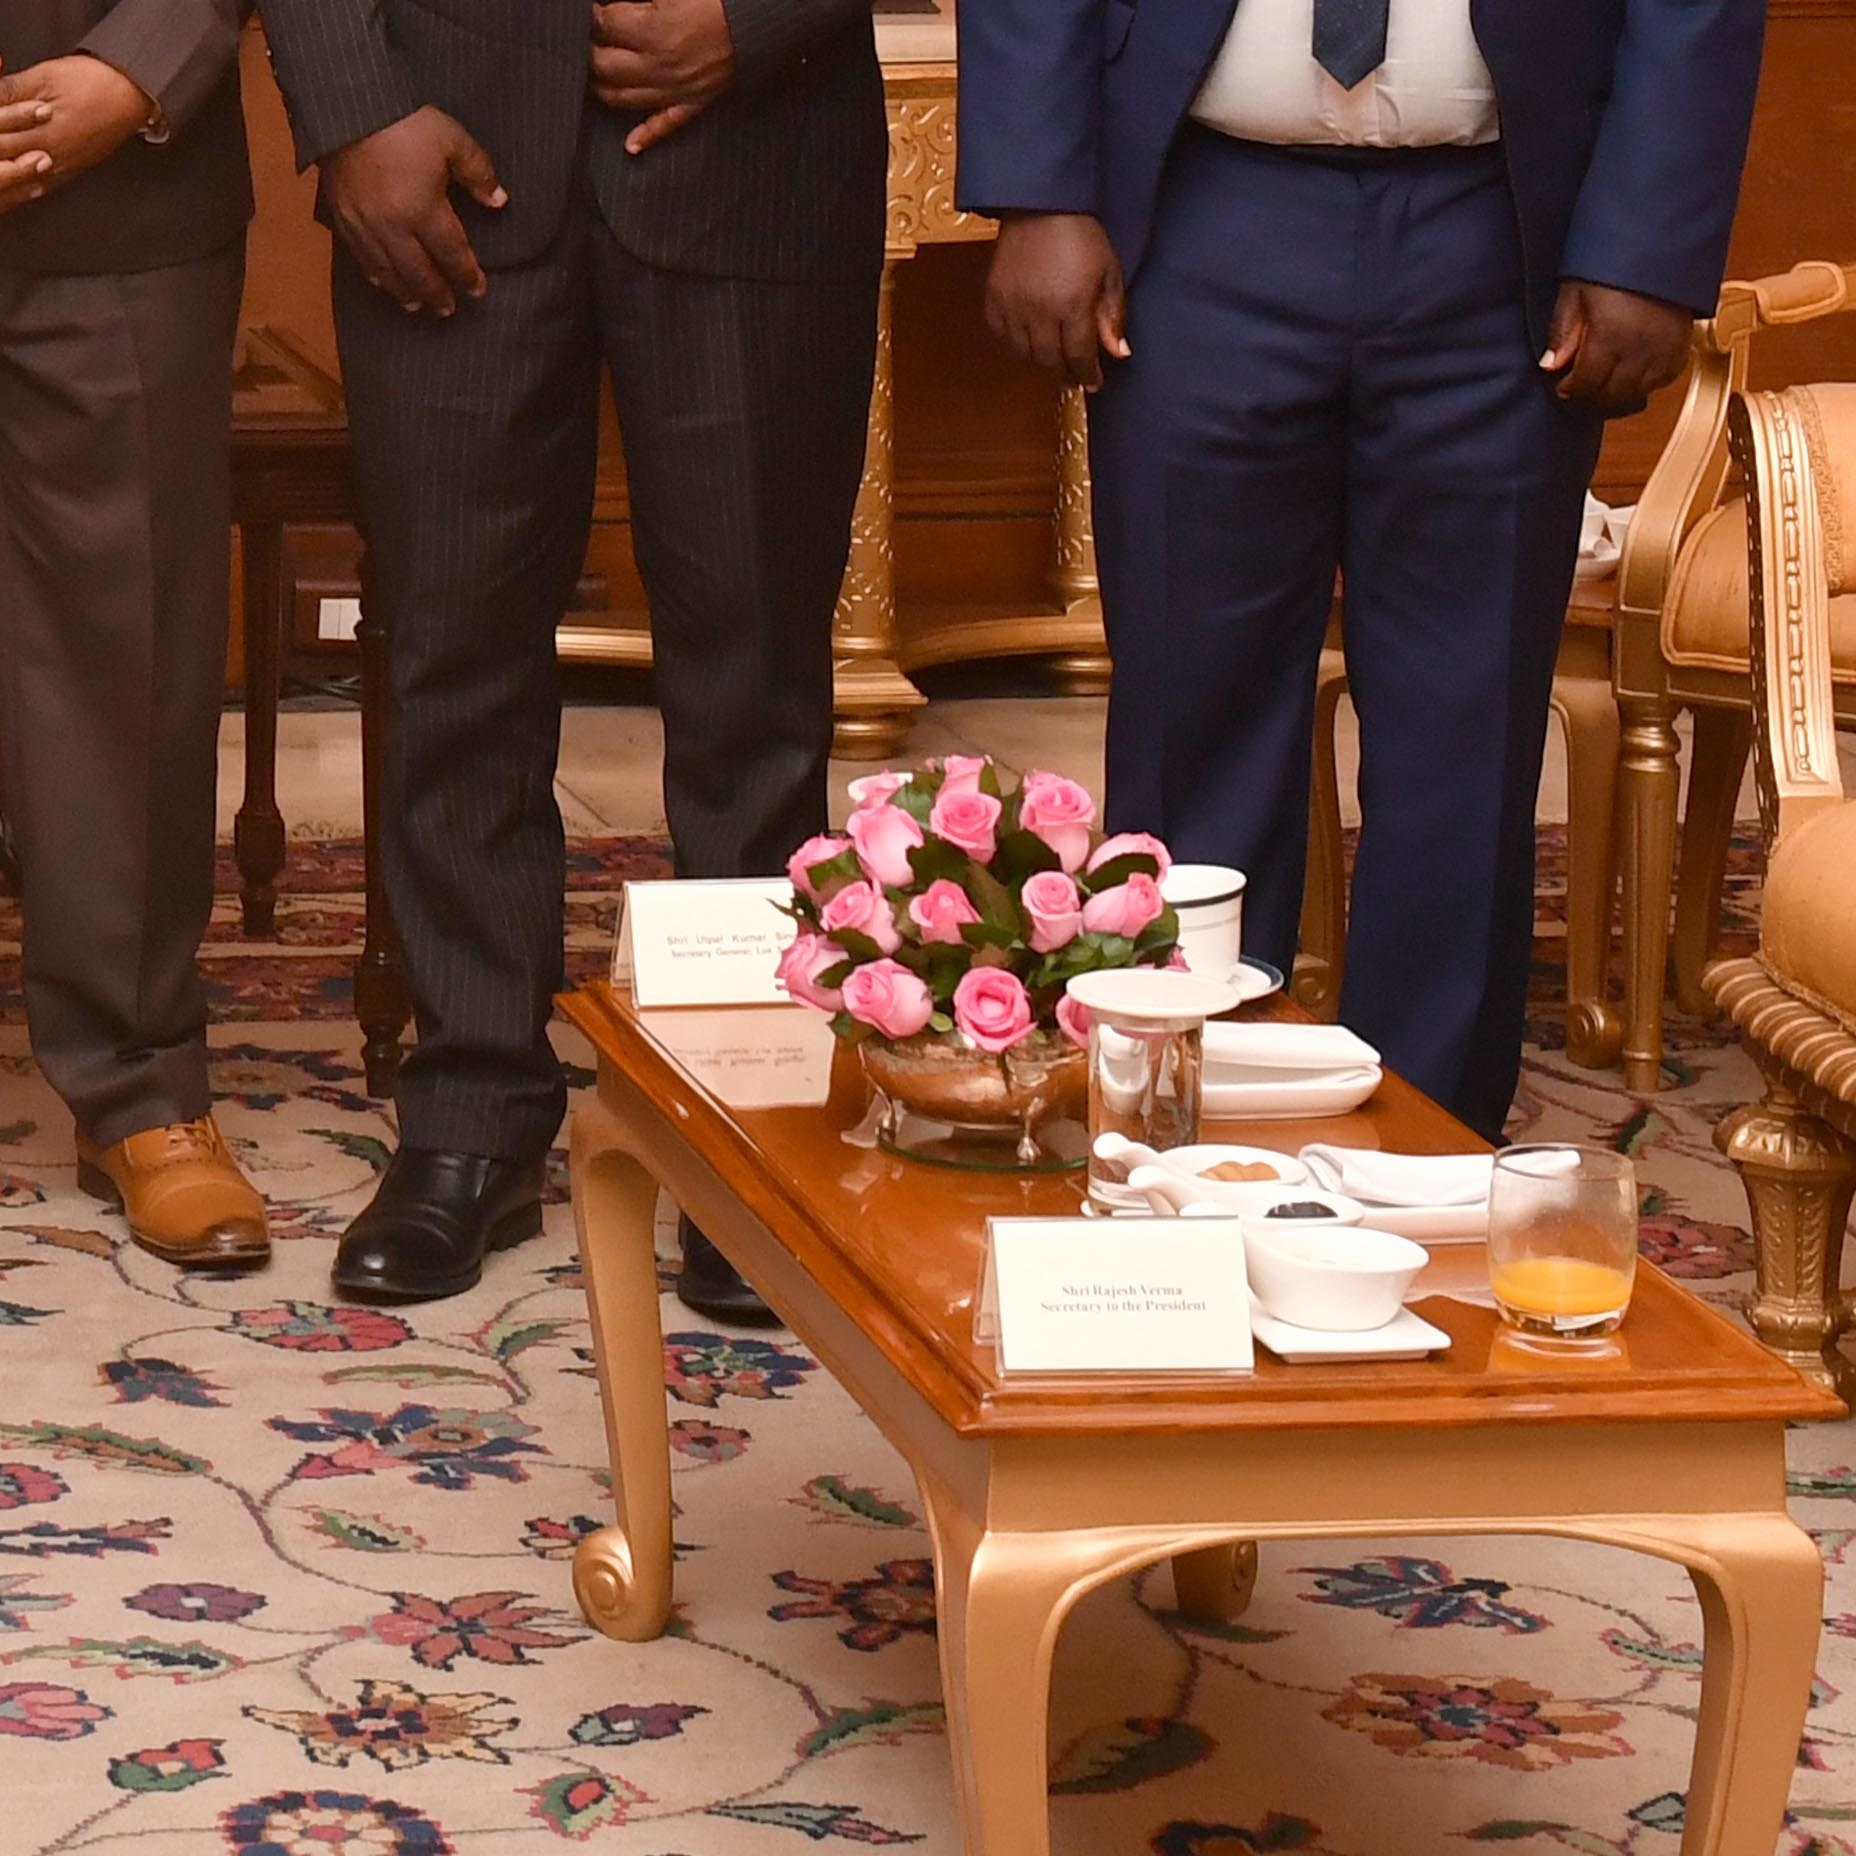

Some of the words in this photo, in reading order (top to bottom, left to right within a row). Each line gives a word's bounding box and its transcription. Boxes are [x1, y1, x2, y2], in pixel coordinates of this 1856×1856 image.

[1061, 1284, 1090, 1296] Shri
[1093, 1283, 1136, 1299] Rajesh
[1140, 1284, 1182, 1296] Verma
[1040, 1303, 1102, 1314] Secretary
[1107, 1301, 1119, 1312] to
[1122, 1300, 1142, 1312] the
[1145, 1300, 1206, 1312] President
